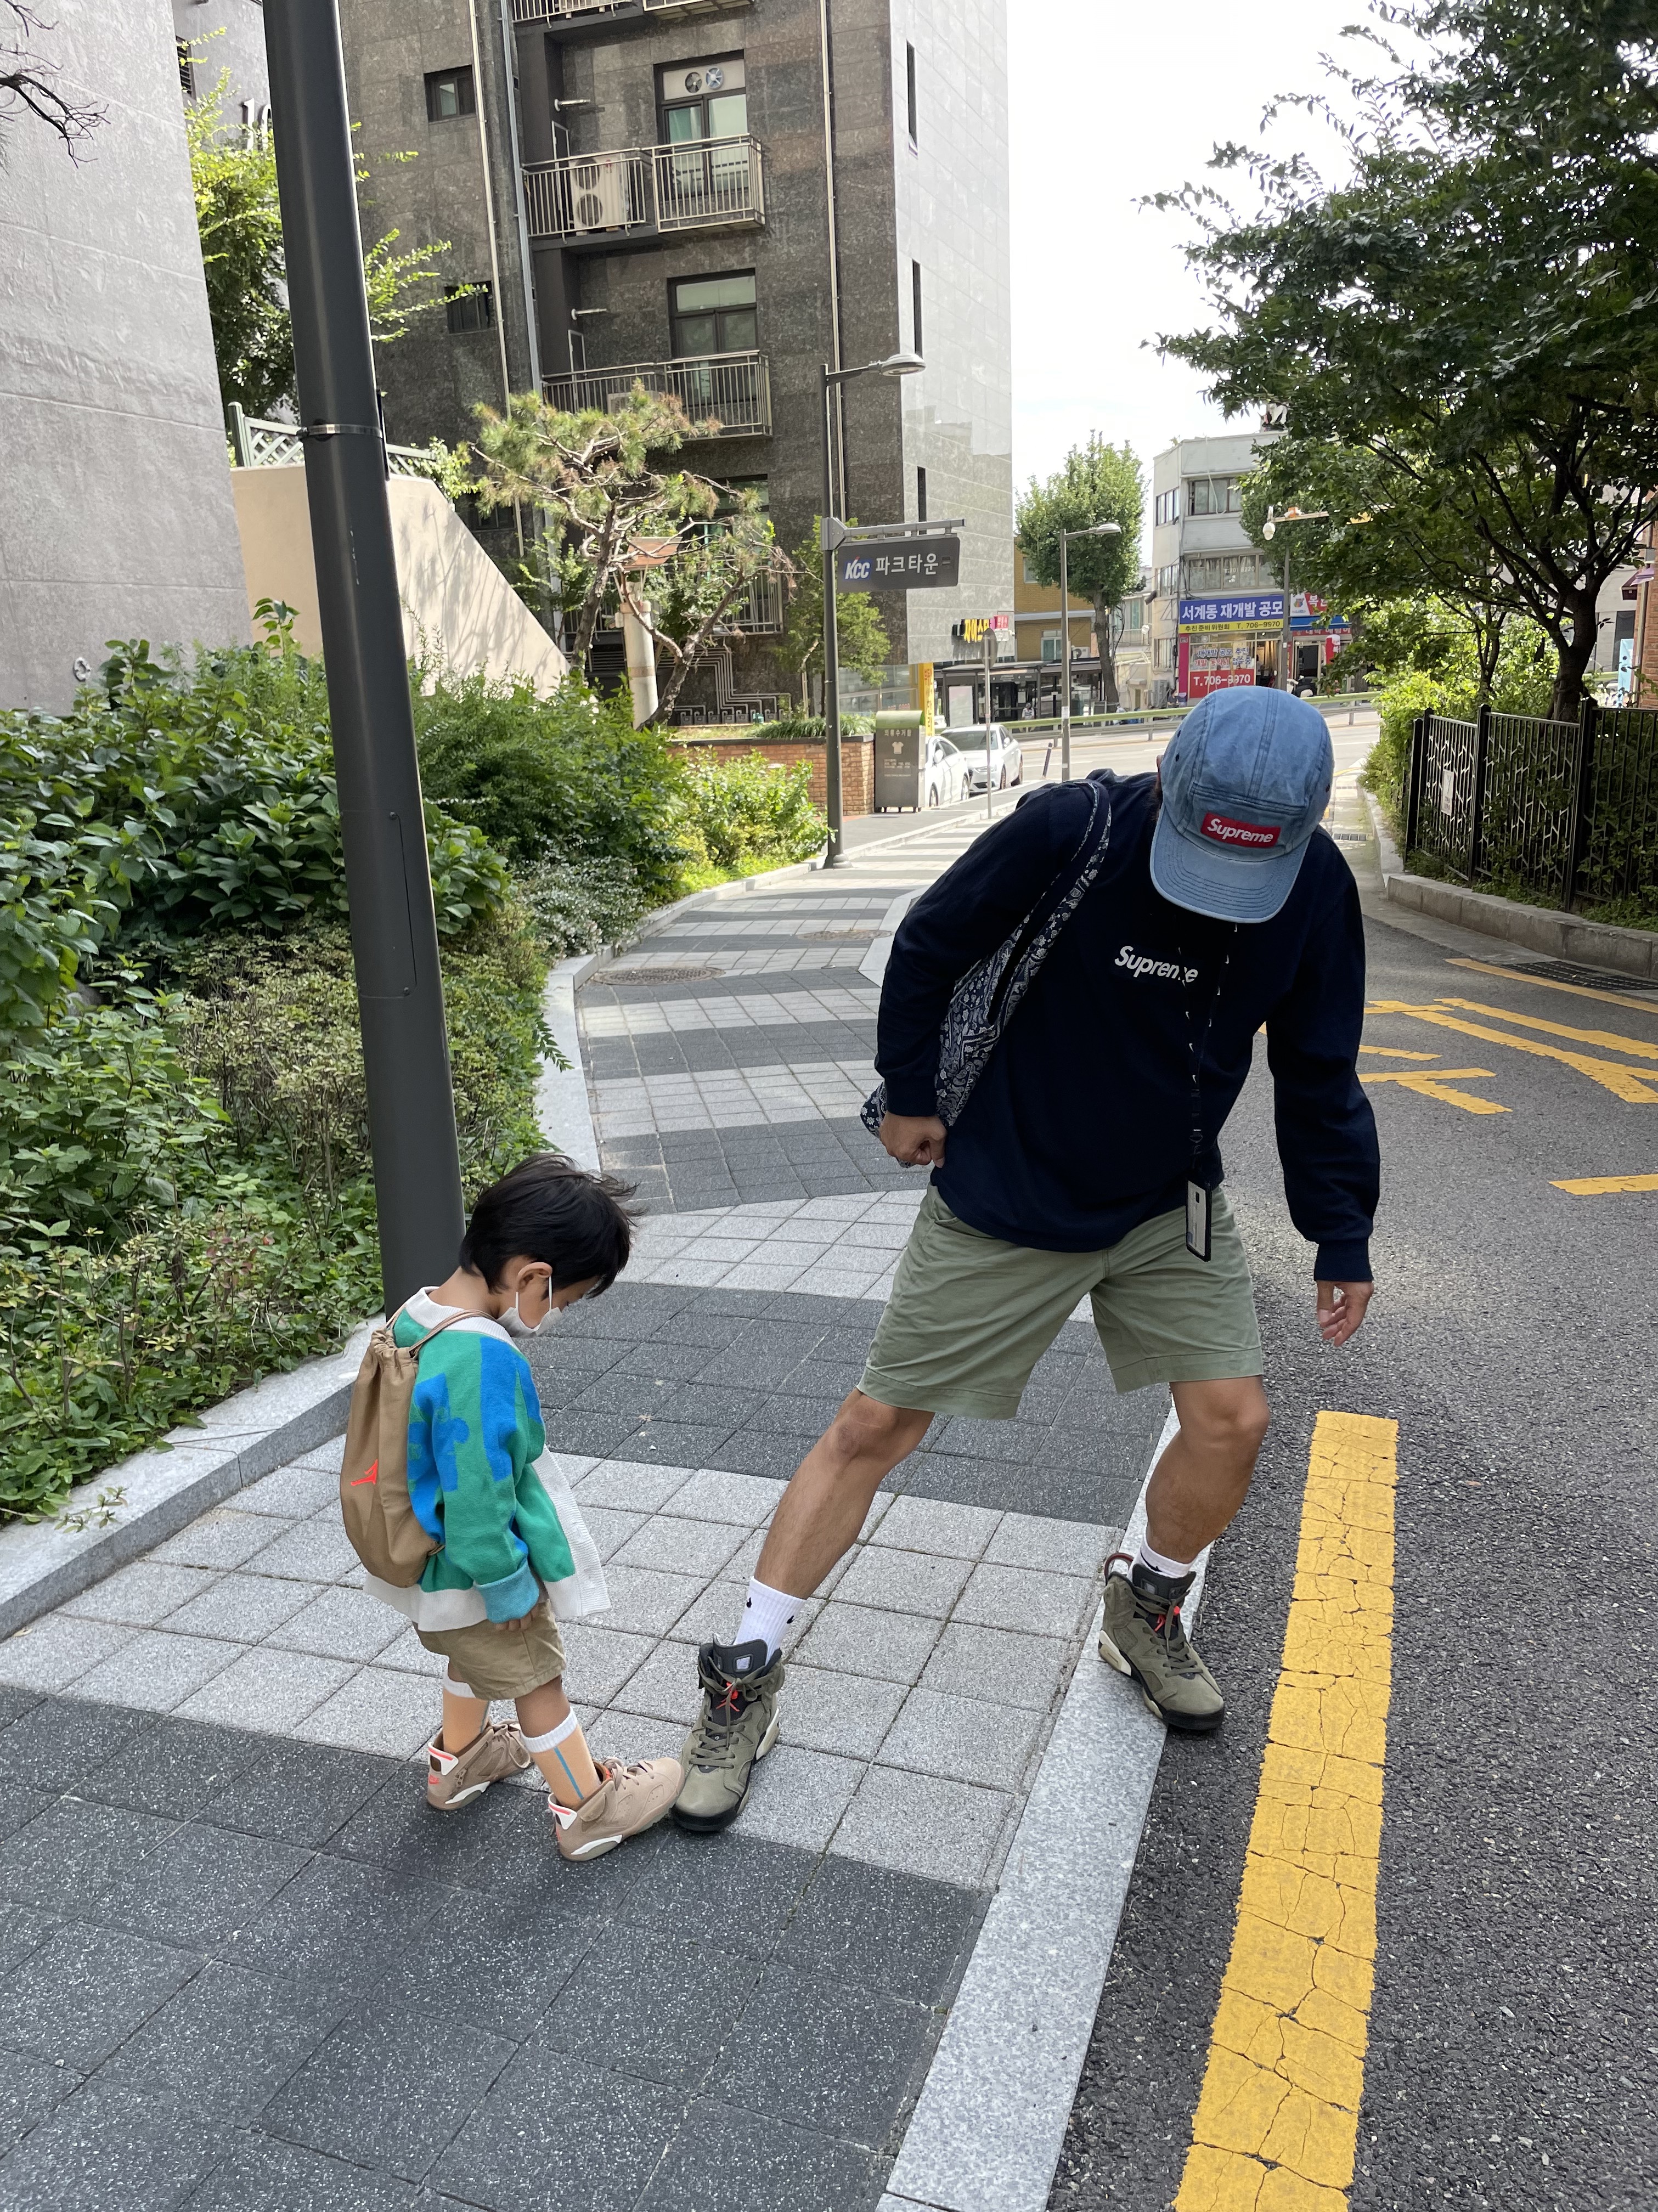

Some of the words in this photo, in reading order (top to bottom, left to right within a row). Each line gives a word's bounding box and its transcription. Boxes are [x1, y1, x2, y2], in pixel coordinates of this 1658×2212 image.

[845, 555, 870, 579] KCC
[875, 553, 939, 575] 파크타운
[1182, 604, 1218, 621] 서계동
[1220, 601, 1256, 619] 재개발
[1259, 600, 1283, 617] 공모
[1185, 623, 1230, 632] 추진준비위원회
[1246, 620, 1281, 629] 706-9970
[1219, 647, 1233, 657] 공모
[1235, 647, 1249, 656] 추진
[1207, 818, 1273, 843] Supreme
